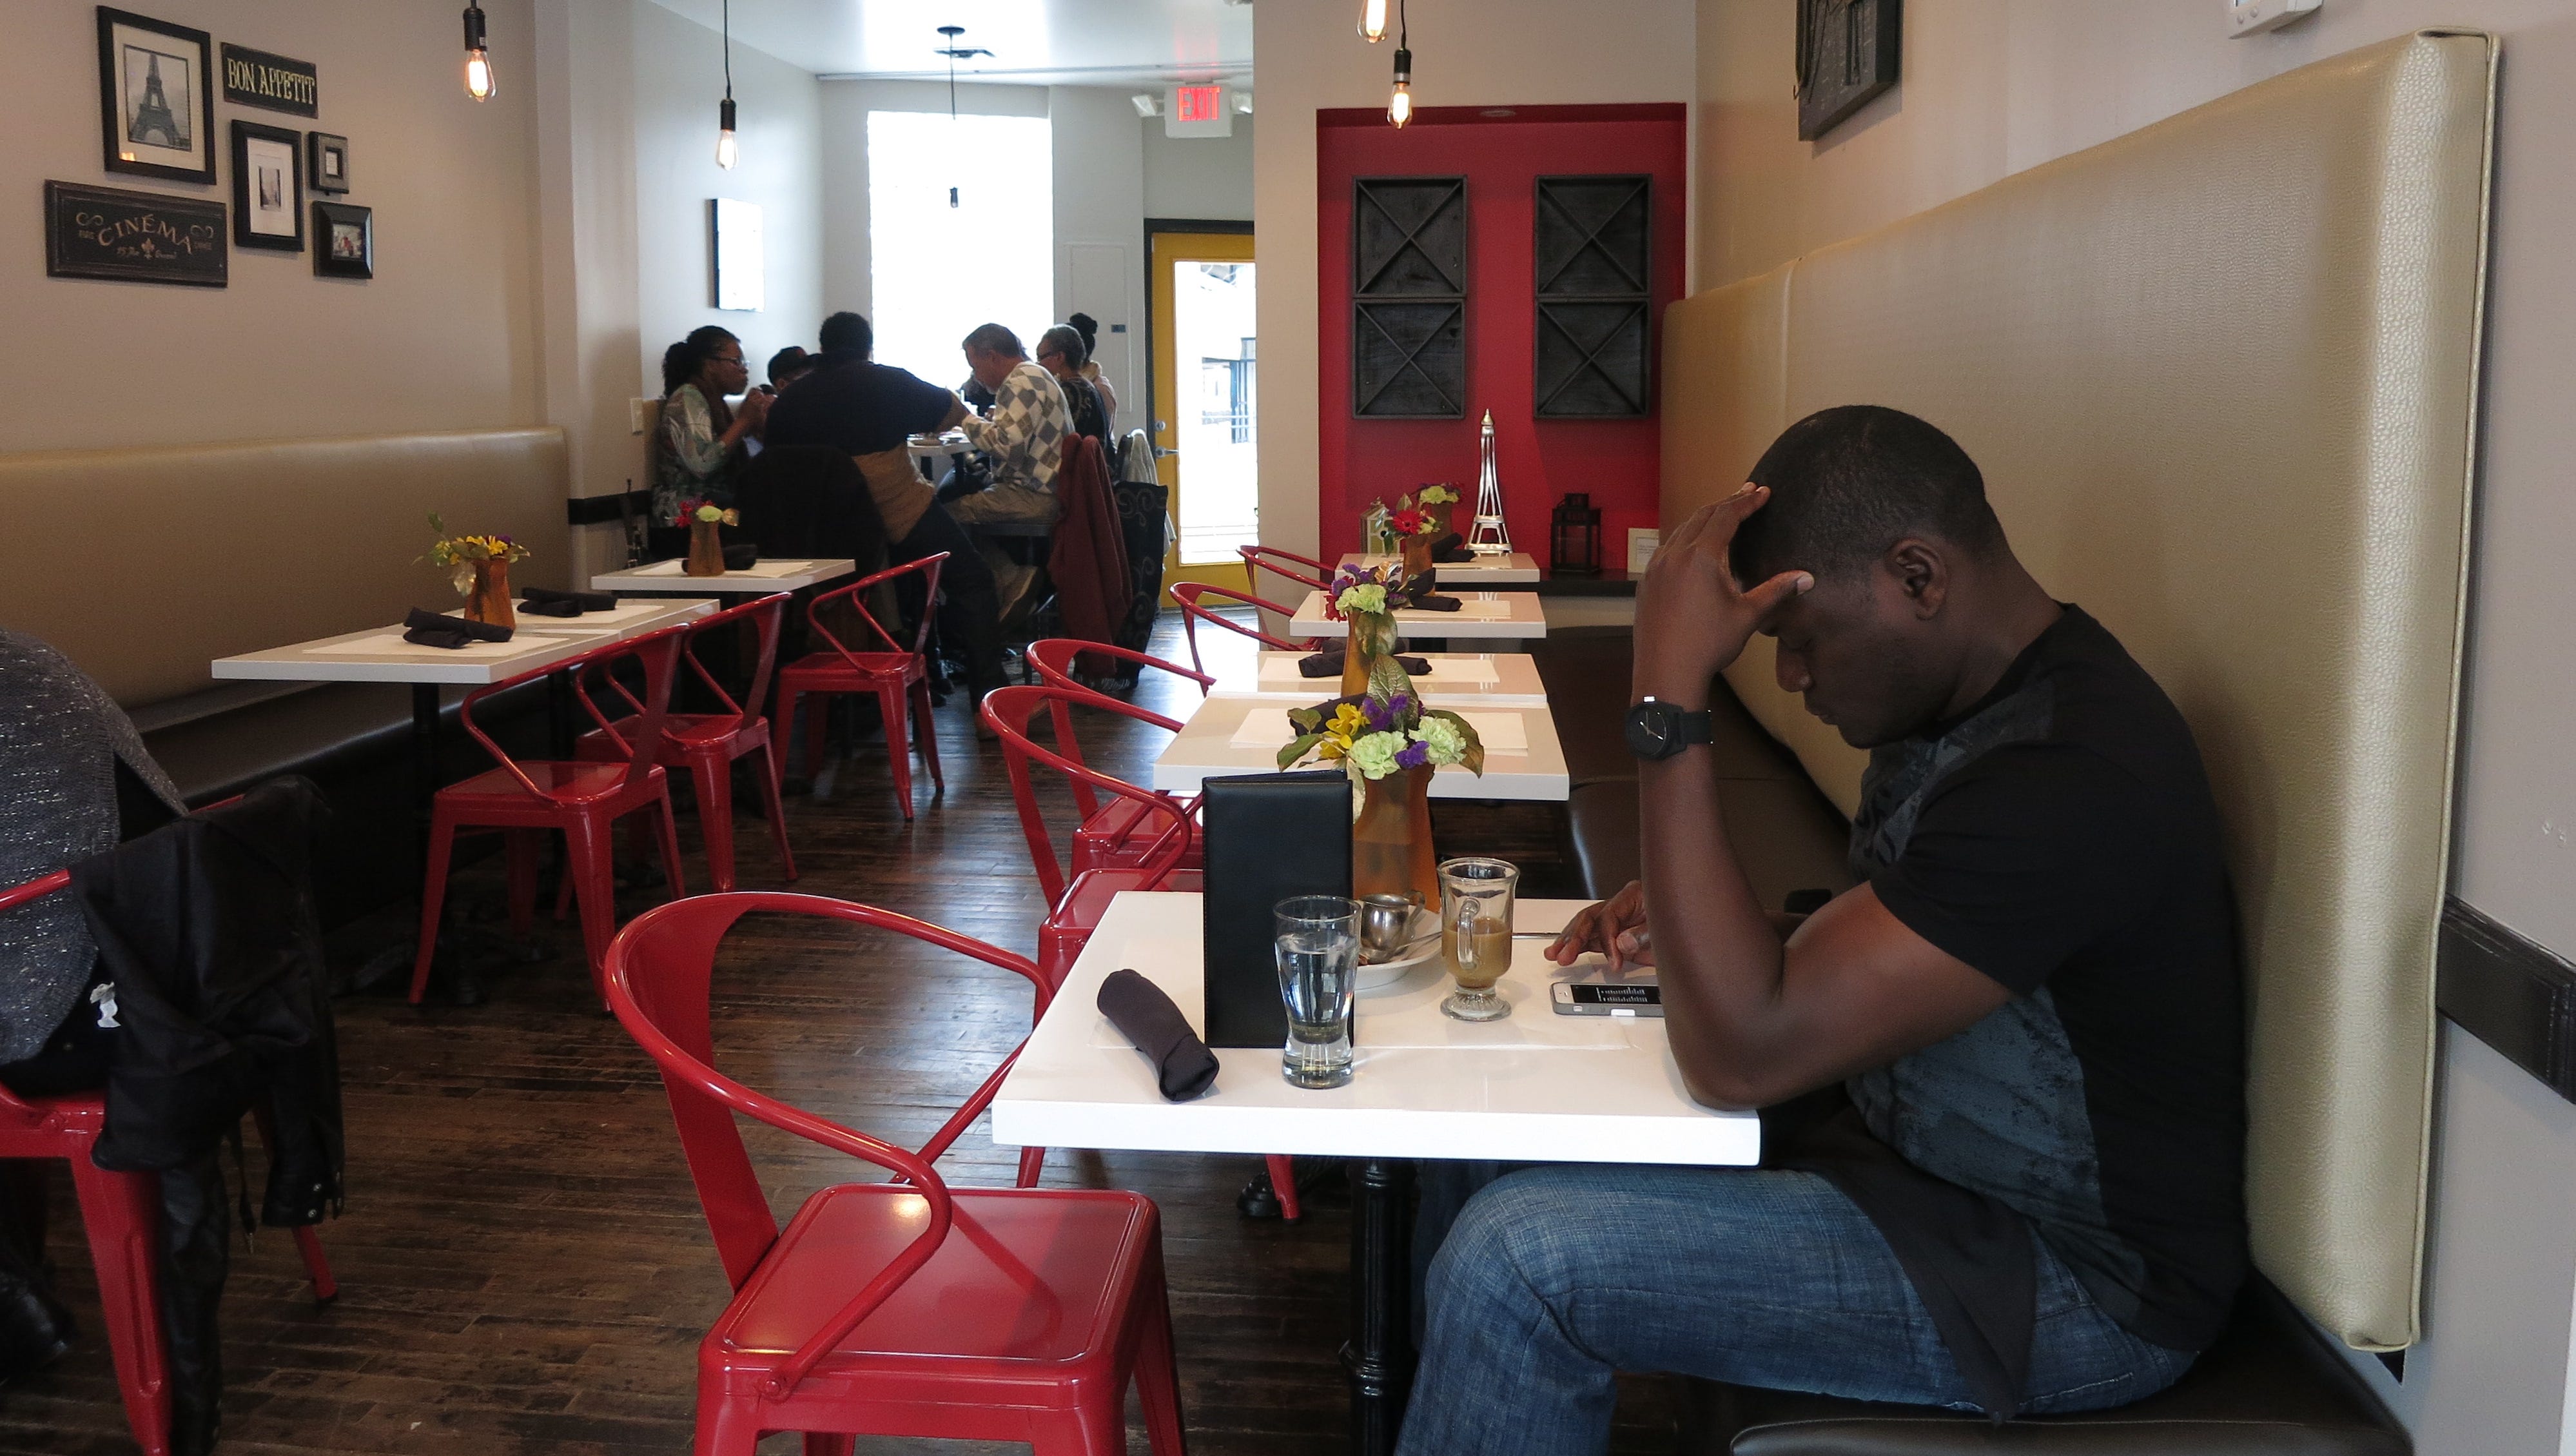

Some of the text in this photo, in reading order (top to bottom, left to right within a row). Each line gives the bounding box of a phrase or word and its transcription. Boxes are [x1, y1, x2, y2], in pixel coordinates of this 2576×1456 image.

[227, 57, 315, 104] BON APPETIT
[1177, 87, 1220, 121] EXIT
